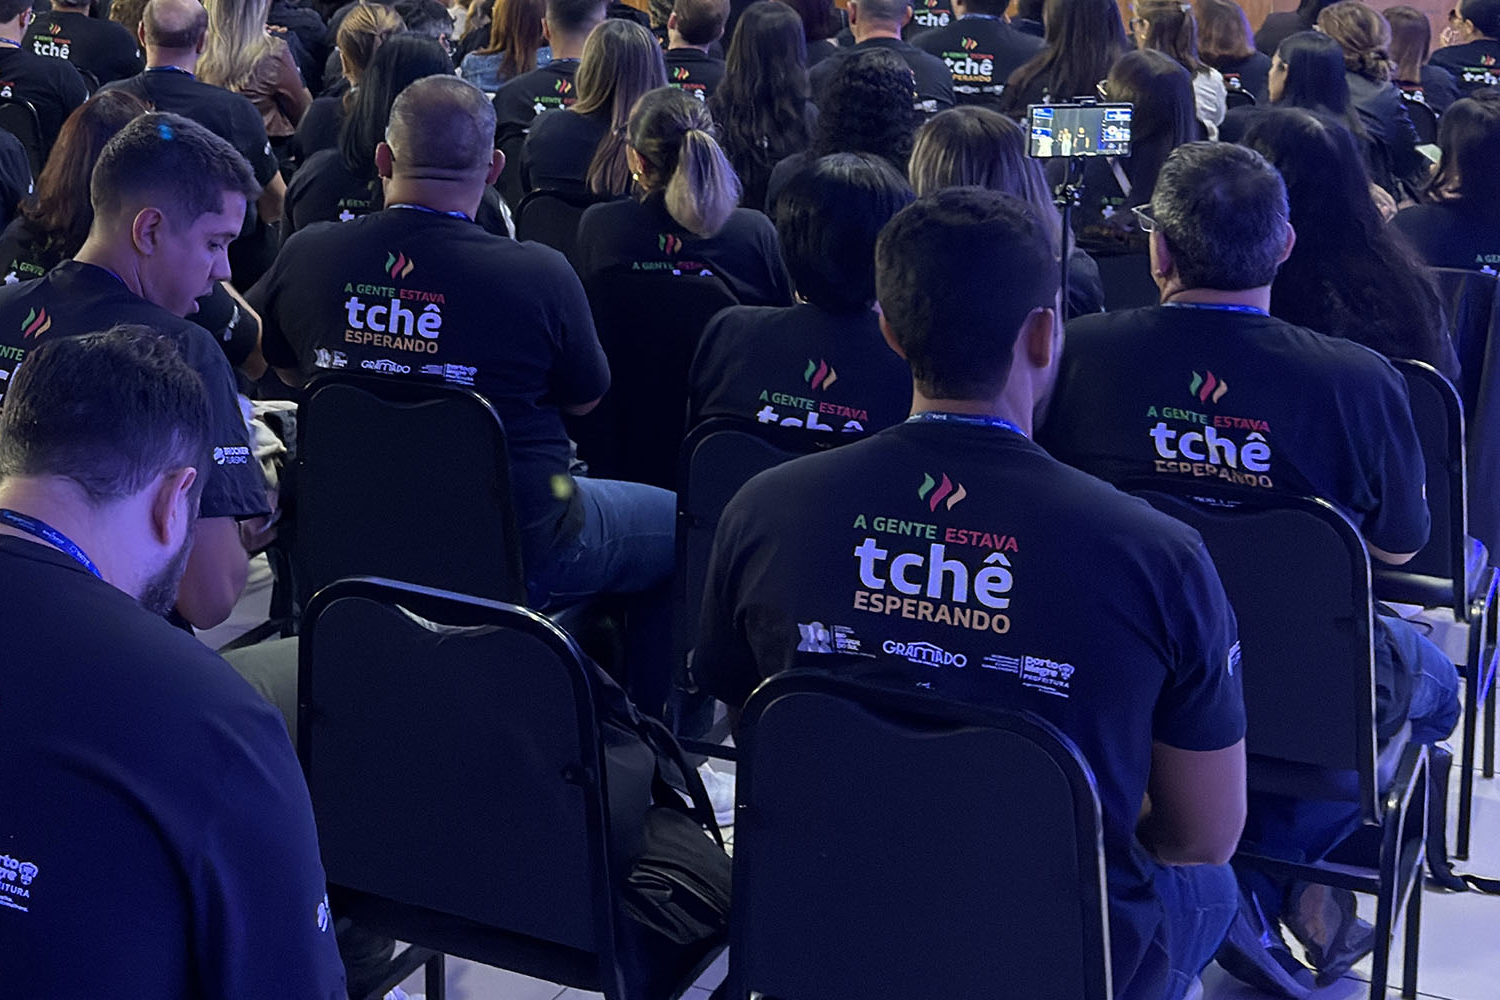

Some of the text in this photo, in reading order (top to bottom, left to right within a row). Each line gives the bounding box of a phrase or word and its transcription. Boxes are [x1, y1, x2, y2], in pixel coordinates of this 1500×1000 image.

[33, 40, 70, 60] tchê
[344, 282, 445, 304] A GENTE ESTAVA
[344, 296, 443, 339] tchê
[344, 329, 439, 354] ESPERANDO
[759, 389, 869, 422] A GENTE ESTAVA
[1146, 405, 1271, 433] A GENTE ESTAVA
[1149, 422, 1271, 472] tchê
[1154, 459, 1273, 488] ESPERANDO
[853, 513, 1019, 553] A GENTE ESTAVA
[854, 537, 1014, 609] tchê
[853, 590, 1011, 634] ESPERANDO
[882, 639, 968, 668] GRAMADO
